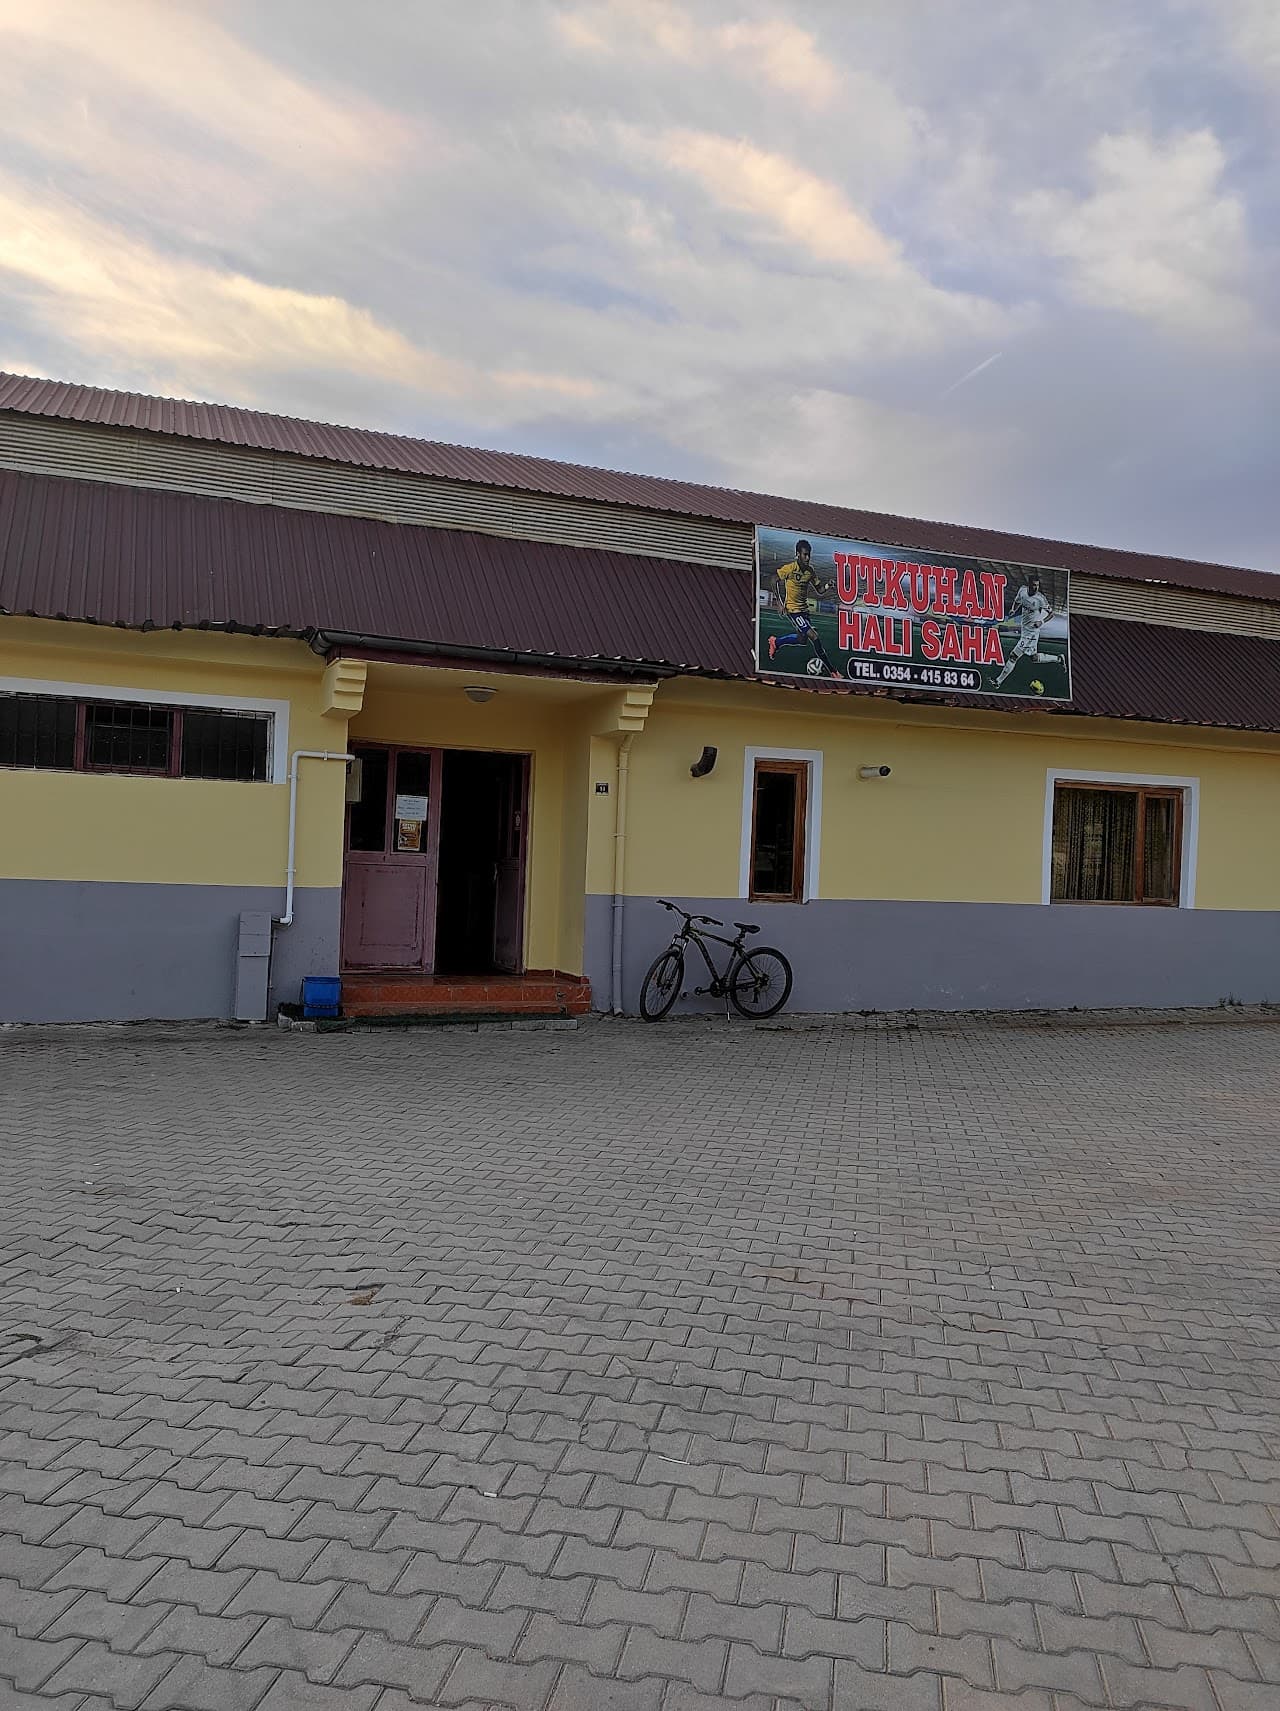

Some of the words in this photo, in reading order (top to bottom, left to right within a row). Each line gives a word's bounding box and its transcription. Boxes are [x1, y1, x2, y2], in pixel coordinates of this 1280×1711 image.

[833, 551, 1007, 621] UTKUHAN
[839, 610, 913, 657] HALI
[920, 620, 1005, 666] SAHA
[854, 661, 881, 678] TEL.
[883, 665, 911, 681] 0354
[920, 669, 941, 684] 415
[944, 671, 958, 685] 83
[960, 672, 975, 687] 64
